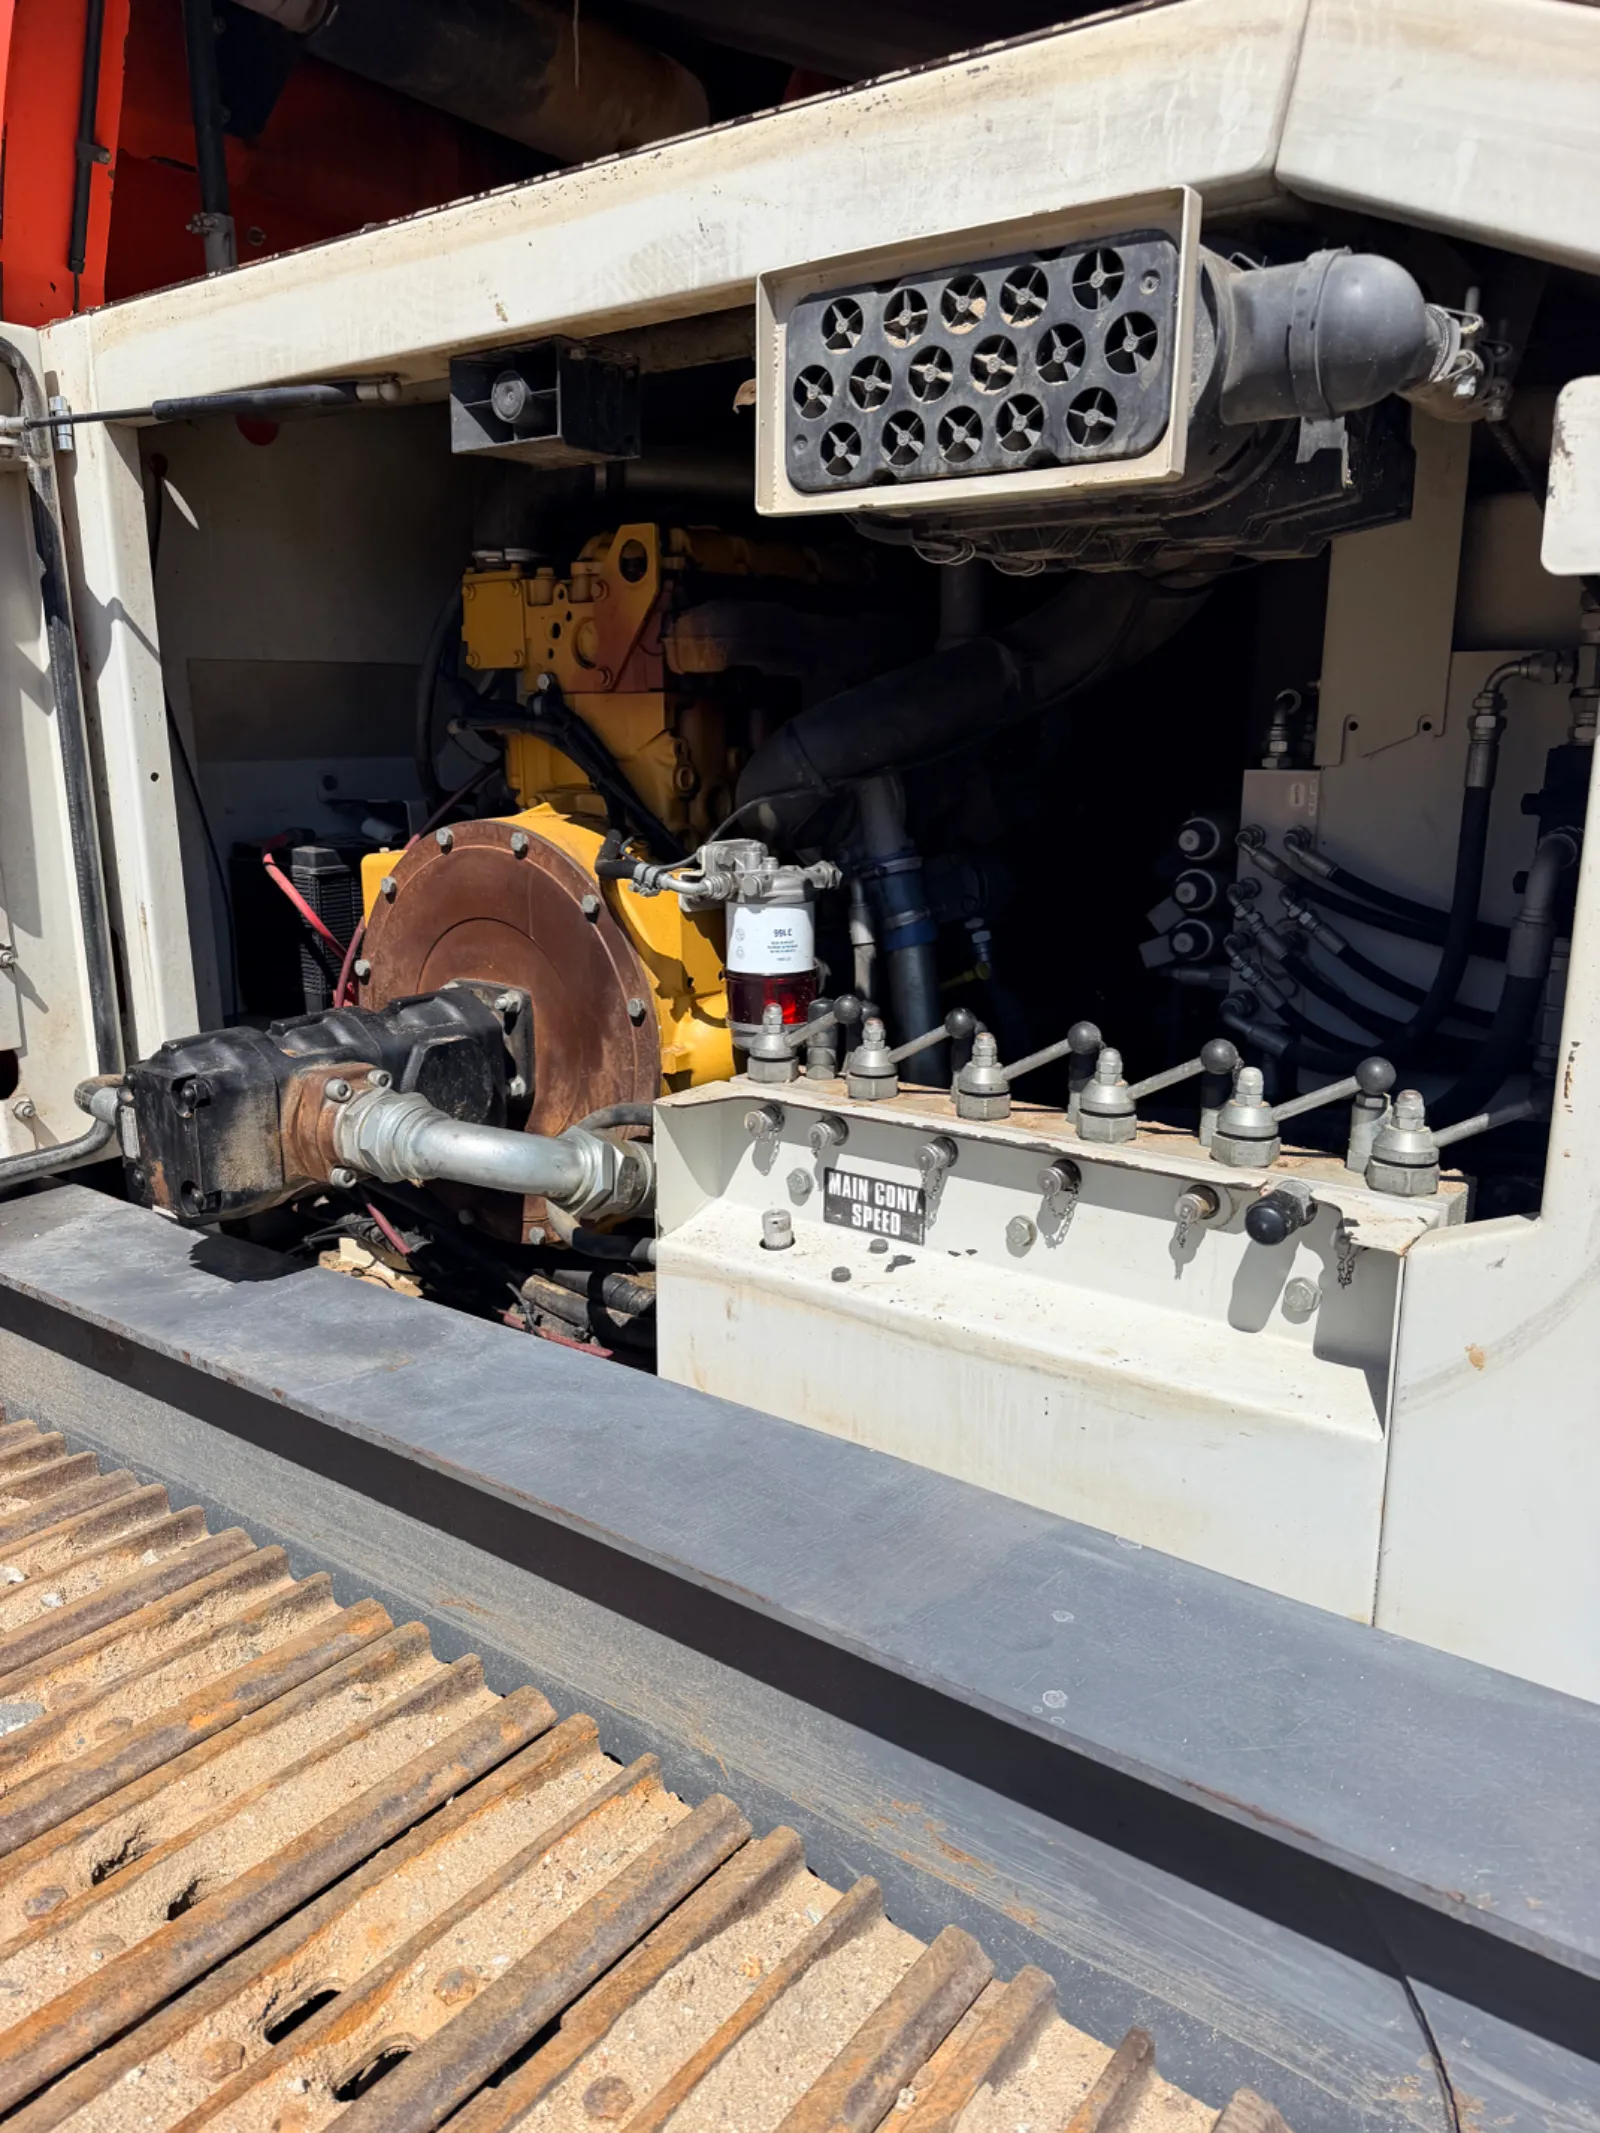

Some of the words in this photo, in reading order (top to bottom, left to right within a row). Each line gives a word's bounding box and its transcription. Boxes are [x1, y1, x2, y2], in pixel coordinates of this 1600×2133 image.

[828, 1171, 869, 1202] MAIN
[874, 1181, 922, 1215] CONV.
[851, 1203, 901, 1236] SPEED
